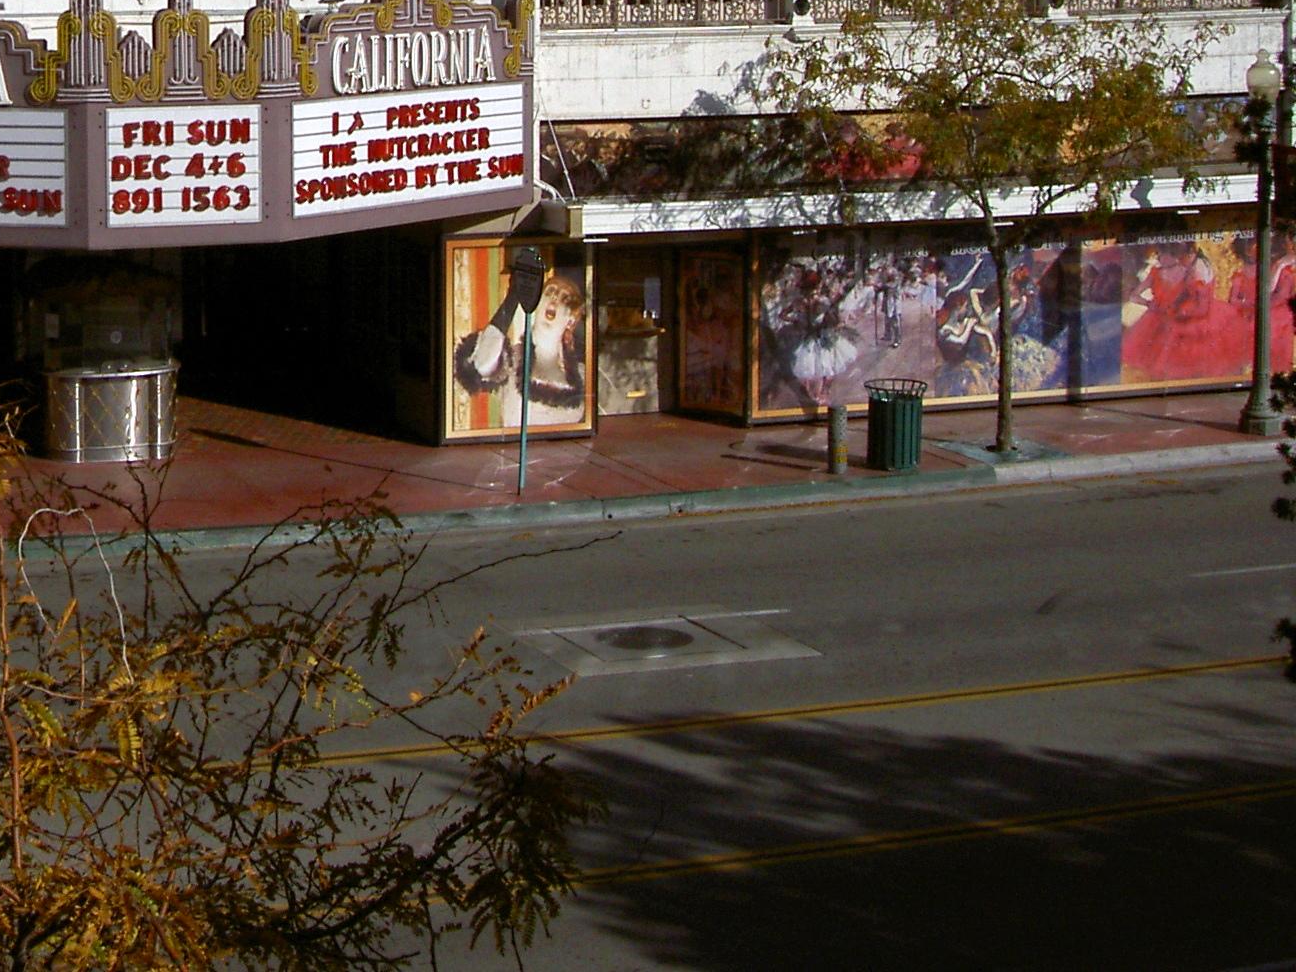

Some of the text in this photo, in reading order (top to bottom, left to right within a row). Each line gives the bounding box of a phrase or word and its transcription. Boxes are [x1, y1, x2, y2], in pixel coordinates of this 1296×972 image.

[332, 23, 497, 95] CALIFORNIA
[386, 97, 481, 131] PRESENTS
[122, 117, 251, 148] FRI SUN
[319, 127, 491, 169] THE NUTCRACKER
[111, 154, 172, 182] DEC
[295, 153, 524, 204] SPONSORED BY THE SUN
[112, 184, 251, 215] 891 1563
